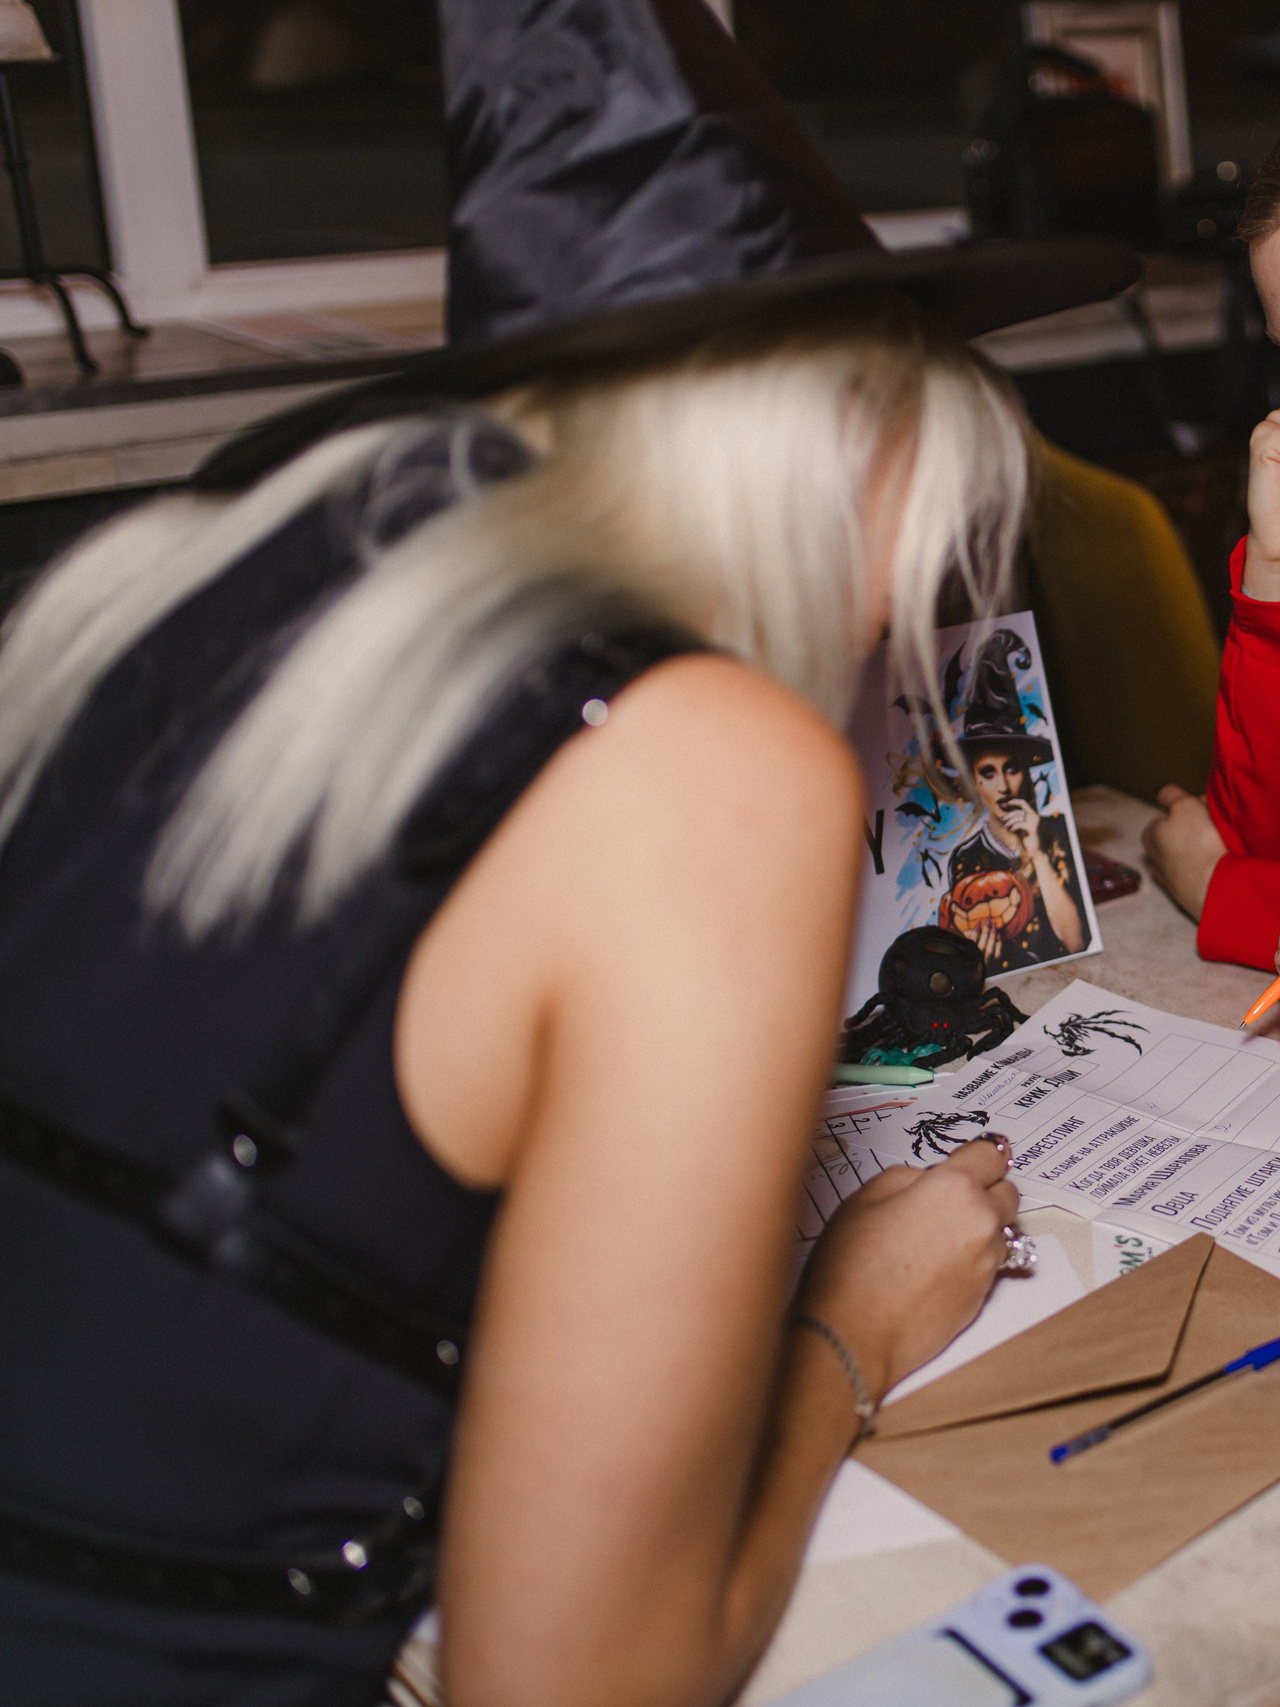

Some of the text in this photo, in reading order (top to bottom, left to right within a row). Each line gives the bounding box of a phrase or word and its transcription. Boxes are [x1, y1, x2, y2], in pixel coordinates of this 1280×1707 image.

[952, 1068, 998, 1100] НАЗВАНИЕ
[1014, 1069, 1082, 1108] КРИК ДУШИ
[1013, 1116, 1086, 1170] АРМРЕСТЛИНГ
